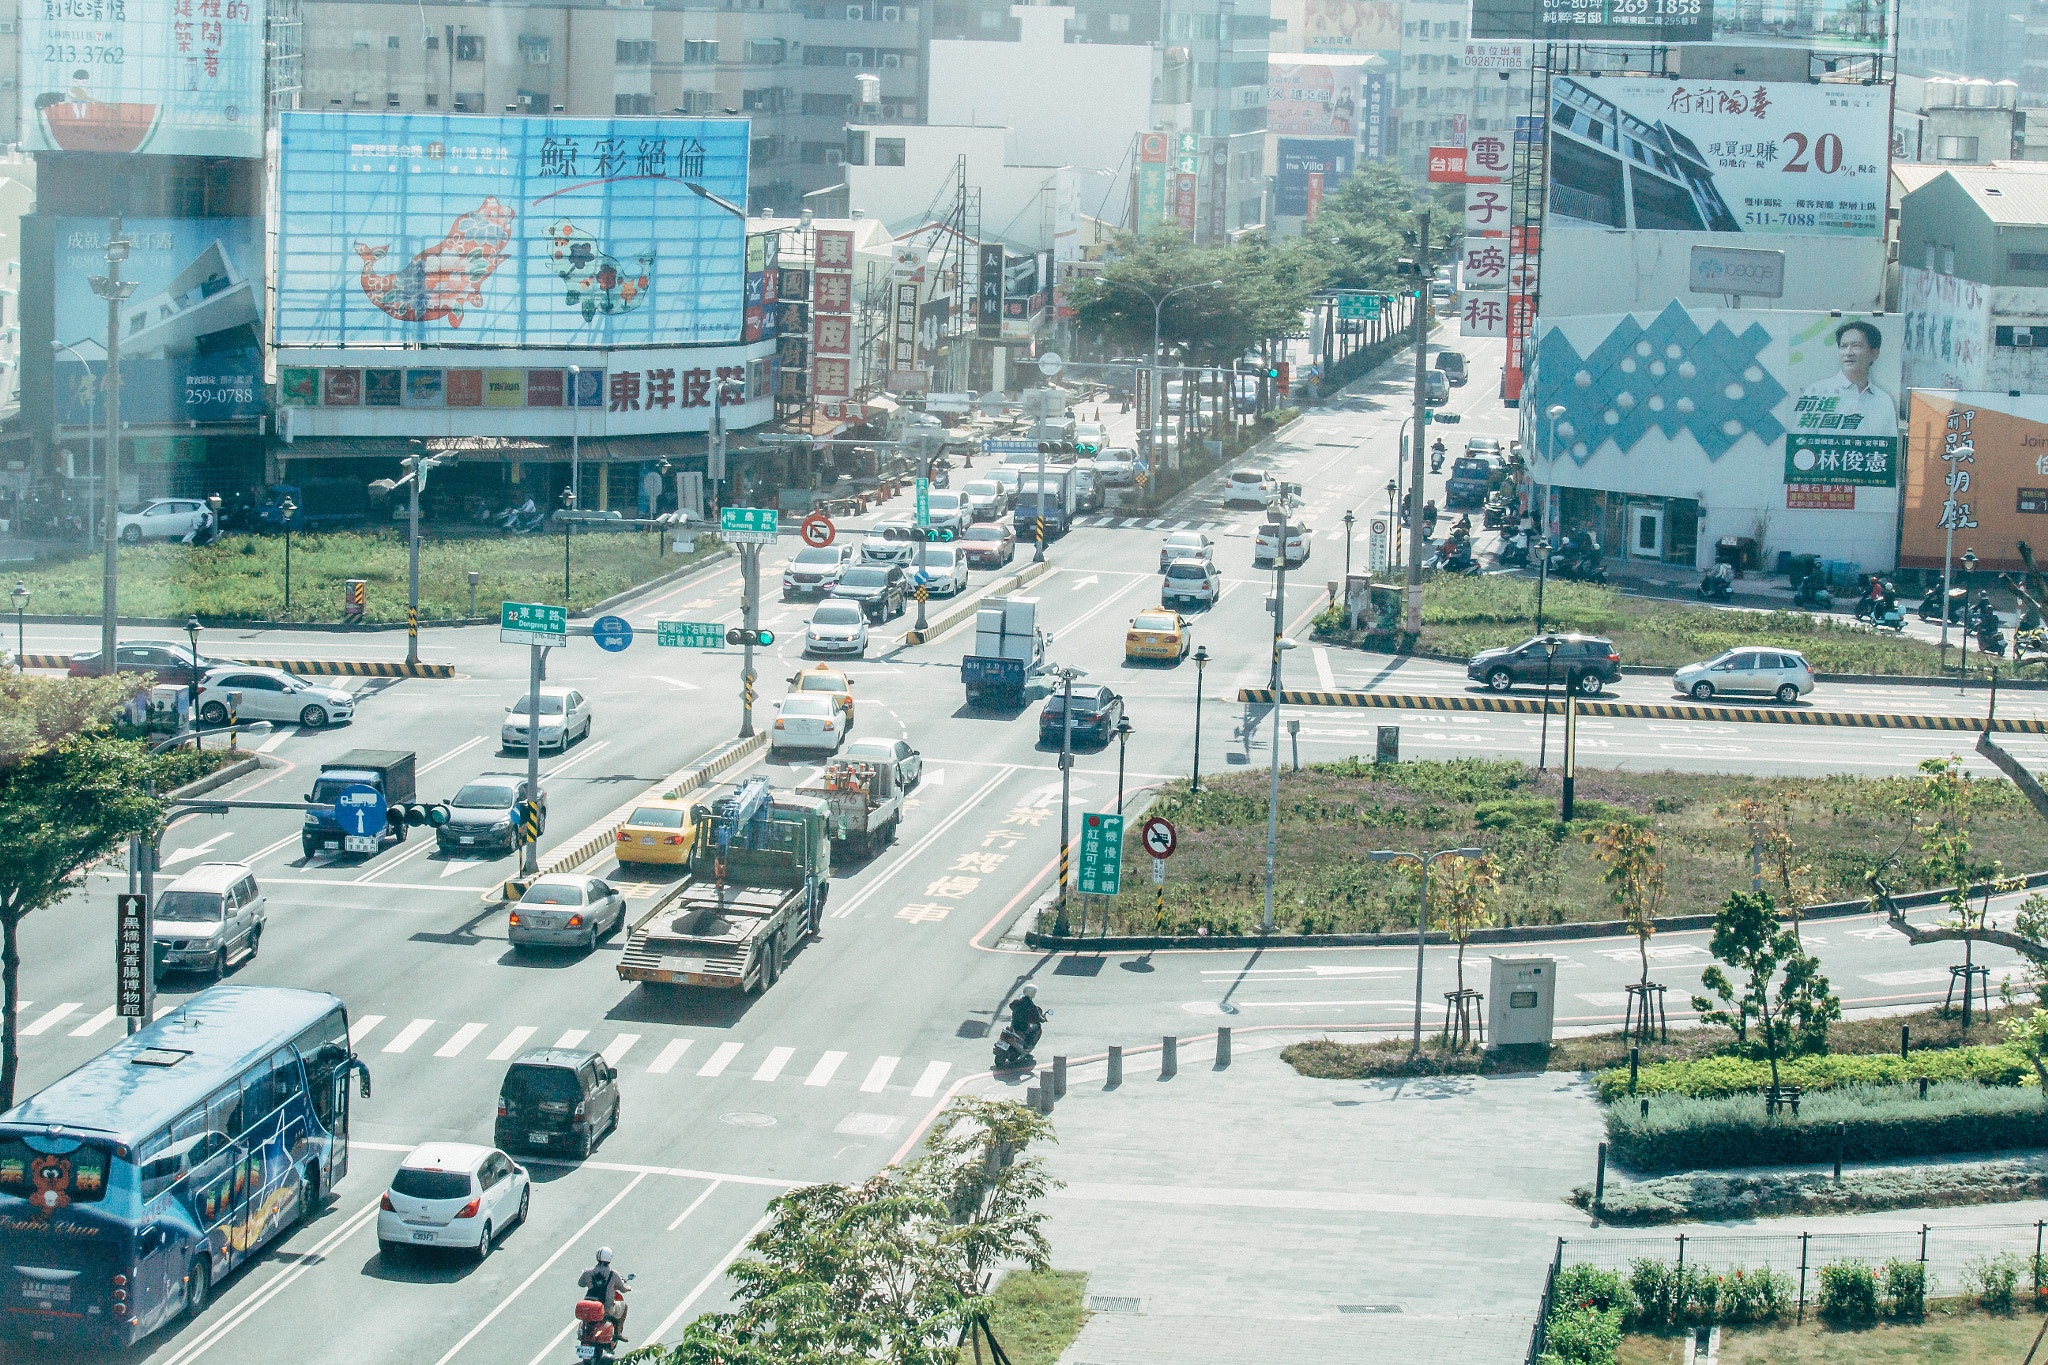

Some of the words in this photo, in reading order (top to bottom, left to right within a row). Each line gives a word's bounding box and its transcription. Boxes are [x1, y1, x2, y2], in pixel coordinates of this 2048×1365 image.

[1613, 0, 1649, 13] 269
[1656, 0, 1702, 13] 1858
[1543, 12, 1602, 24] 純粹名邸
[44, 45, 125, 65] 213.3762
[1465, 46, 1522, 56] 廣告位出租
[1464, 56, 1522, 68] 0928771185
[539, 137, 707, 178] 鯨彩絕倫
[1709, 140, 1779, 162] 現買現賺
[1302, 161, 1324, 171] Villa
[1430, 157, 1466, 172] 台灣
[1745, 212, 1815, 227] 511-7088
[1463, 136, 1509, 332] 電子磅秤
[817, 234, 849, 393] 東洋皮鞋
[186, 388, 253, 405] 259-0788
[1794, 395, 1841, 412] 前進
[1797, 413, 1865, 430] 新國會
[1817, 449, 1888, 473] 林俊憲
[1082, 828, 1100, 892] 紅燈可右轉
[123, 917, 140, 1015] 黑橋牌香腸博物館
